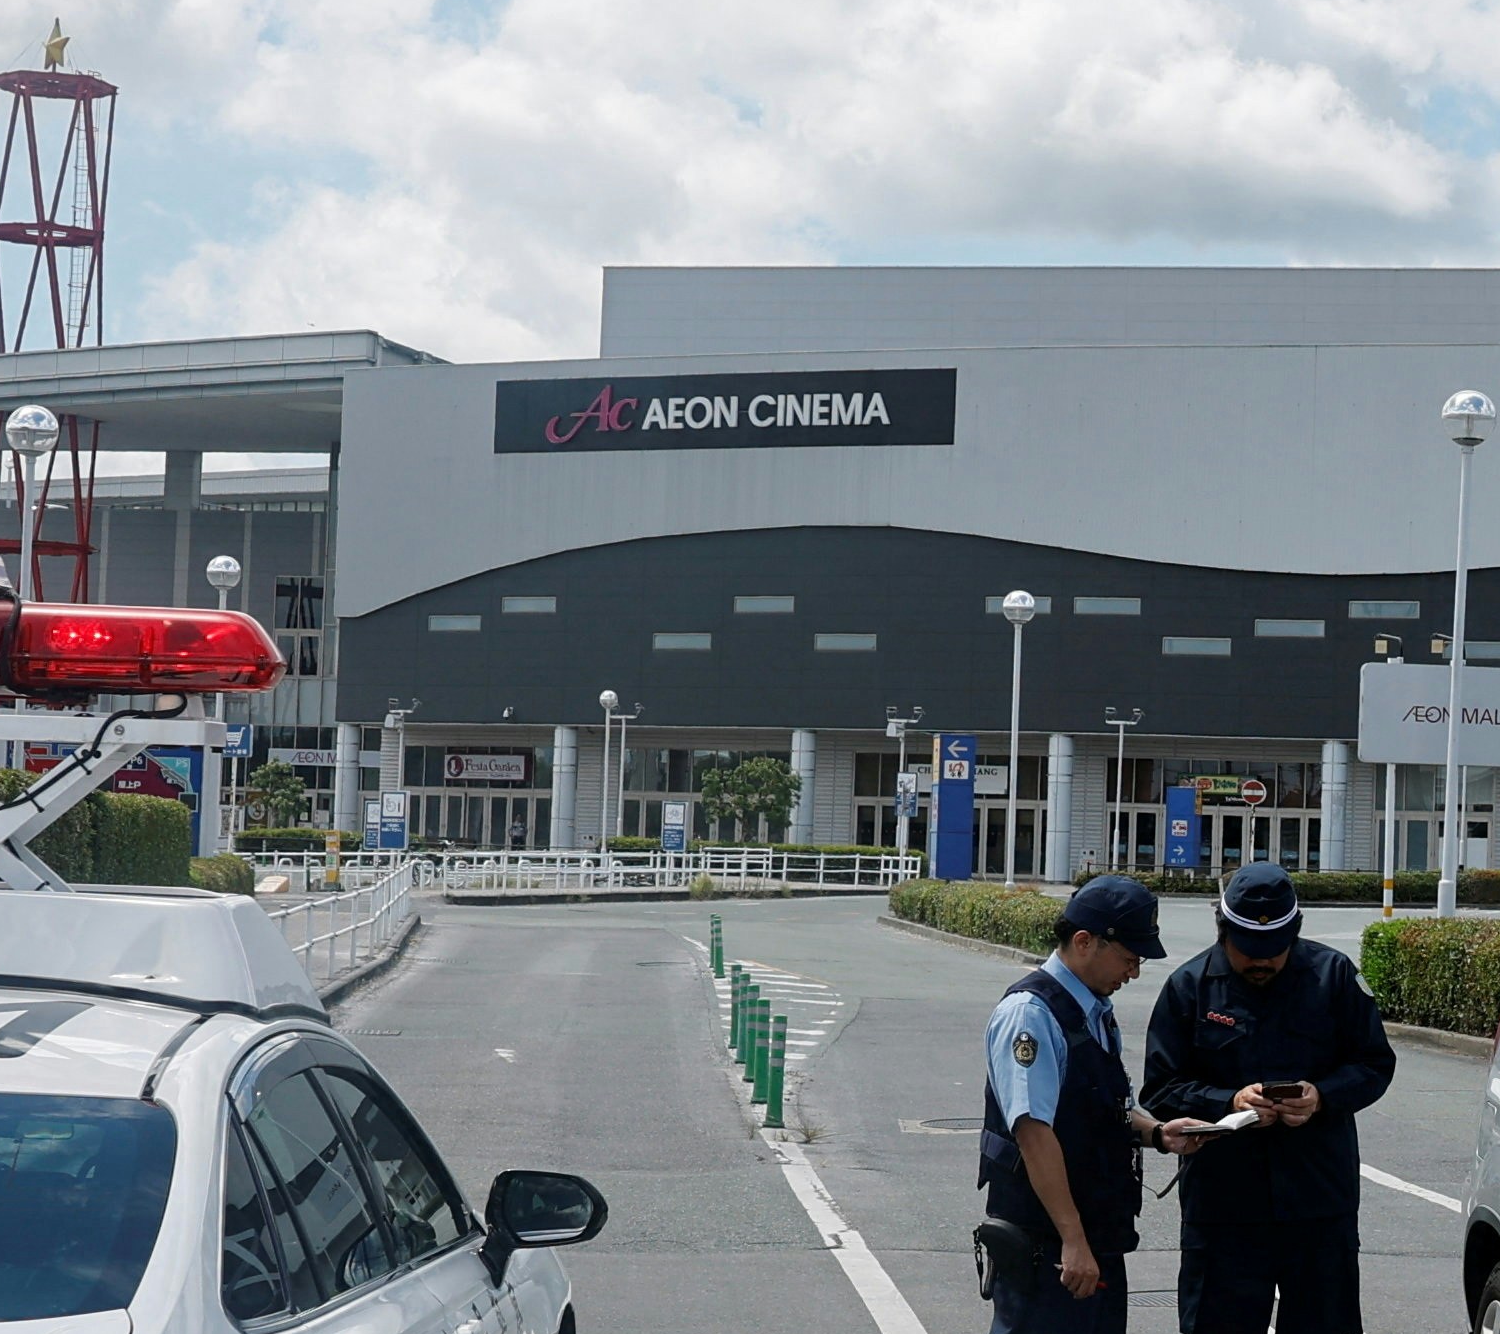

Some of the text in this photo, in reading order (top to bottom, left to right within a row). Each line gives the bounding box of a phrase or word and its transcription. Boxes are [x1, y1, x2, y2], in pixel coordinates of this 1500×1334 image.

[641, 395, 738, 431] AEON
[748, 392, 891, 427] CINEMA
[488, 758, 522, 772] Garden
